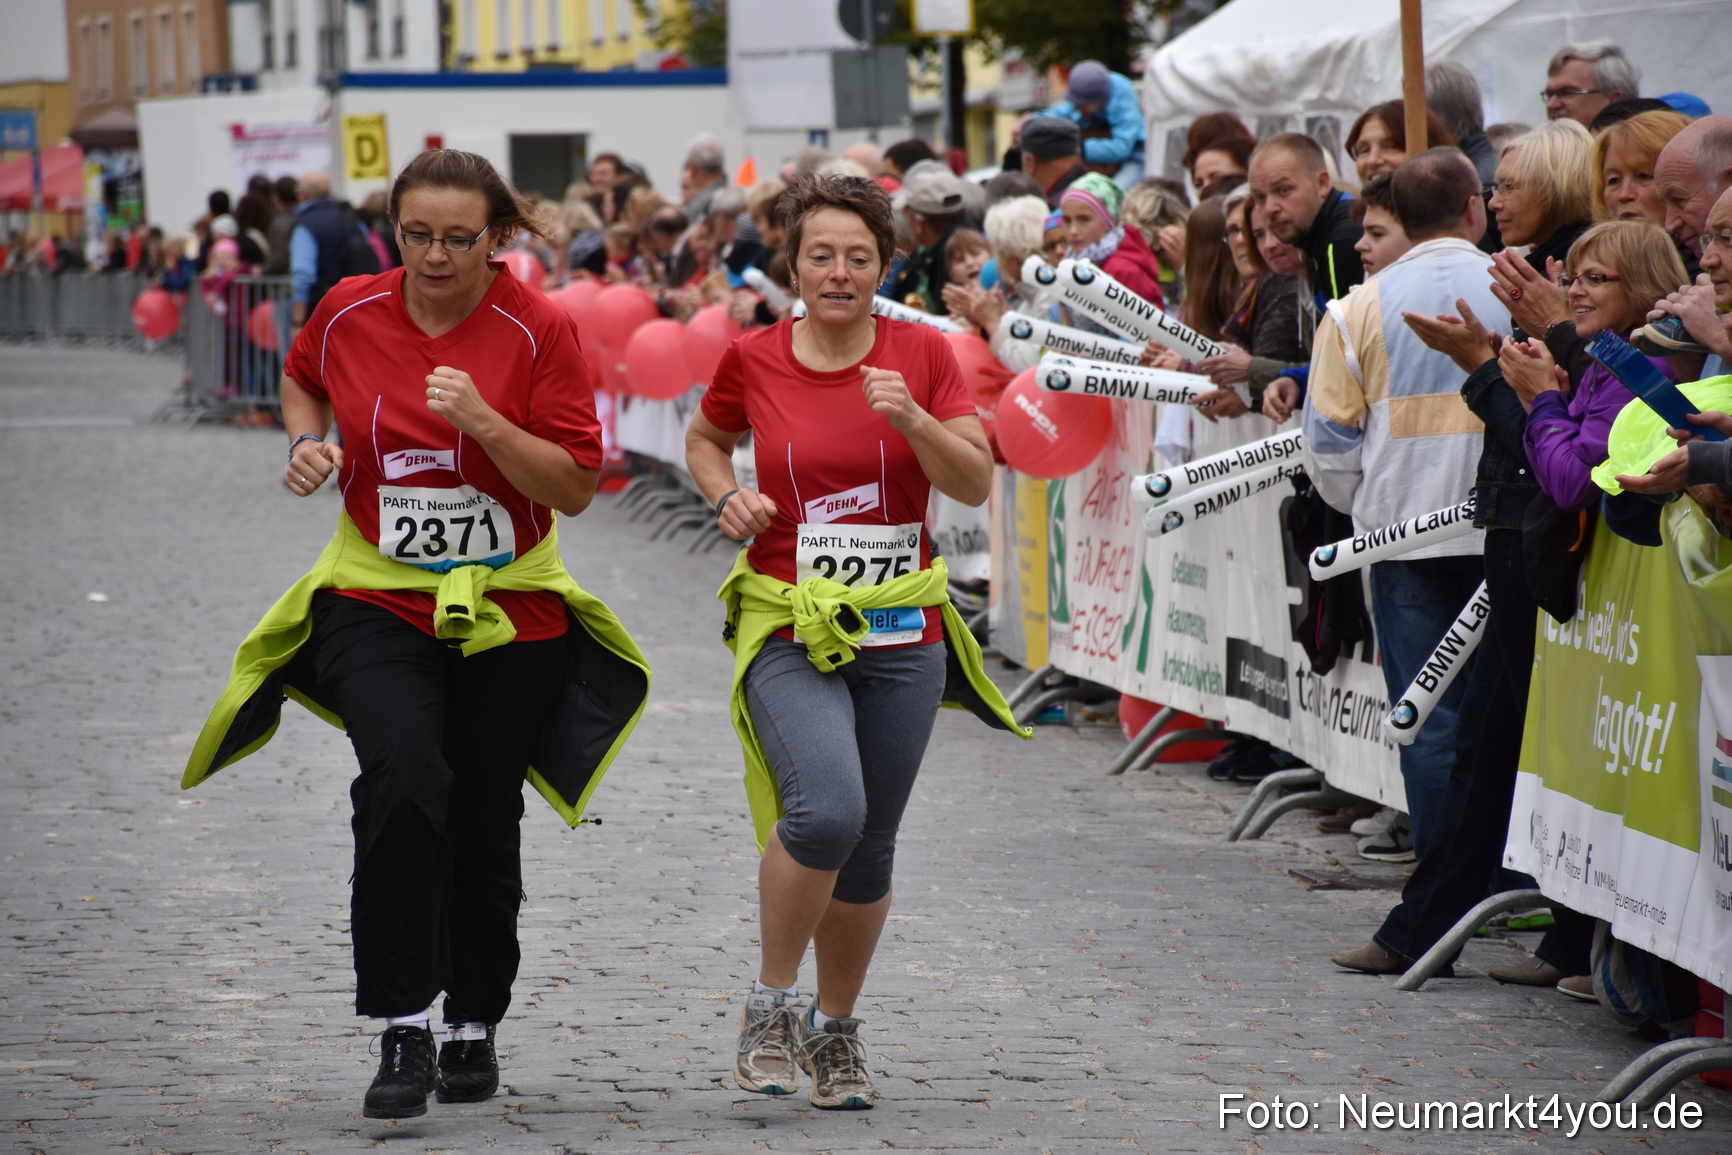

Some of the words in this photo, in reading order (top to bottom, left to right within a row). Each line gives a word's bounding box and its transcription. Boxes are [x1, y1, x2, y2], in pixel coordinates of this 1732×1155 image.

[355, 133, 379, 167] D
[1104, 282, 1155, 320] BMW
[1084, 375, 1139, 398] BMW
[405, 455, 436, 468] DEHN
[383, 496, 424, 511] PARTL
[826, 496, 858, 515] DEHN
[1194, 485, 1241, 520] BMW
[395, 508, 499, 559] 2371
[801, 536, 846, 548] PARTL
[850, 537, 905, 550] Neumarkt
[1352, 518, 1410, 554] BMW
[812, 555, 912, 588] 2275
[1415, 629, 1461, 693] BMW
